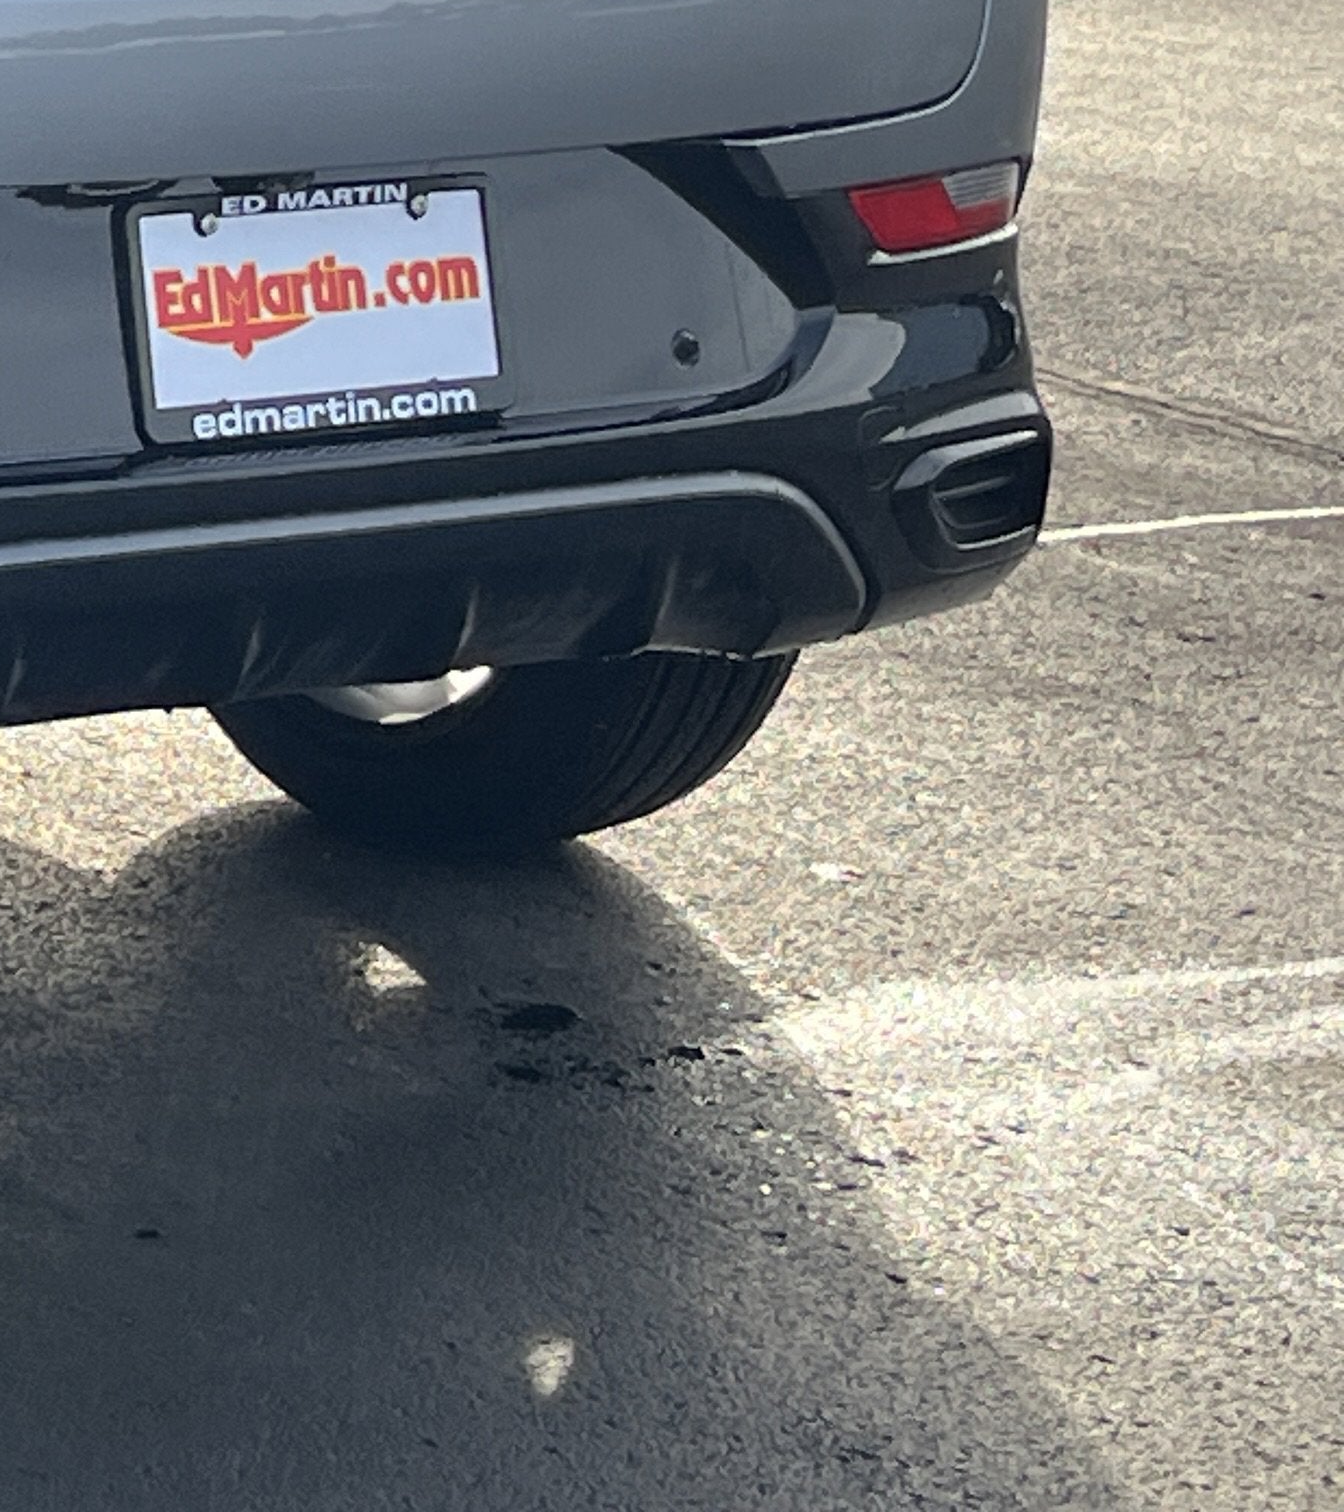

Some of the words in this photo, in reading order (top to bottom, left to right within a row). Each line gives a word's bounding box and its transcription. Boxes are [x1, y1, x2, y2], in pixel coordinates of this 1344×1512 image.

[221, 194, 267, 216] ED
[277, 182, 408, 212] MARTIN
[193, 387, 478, 440] edmartin.com
